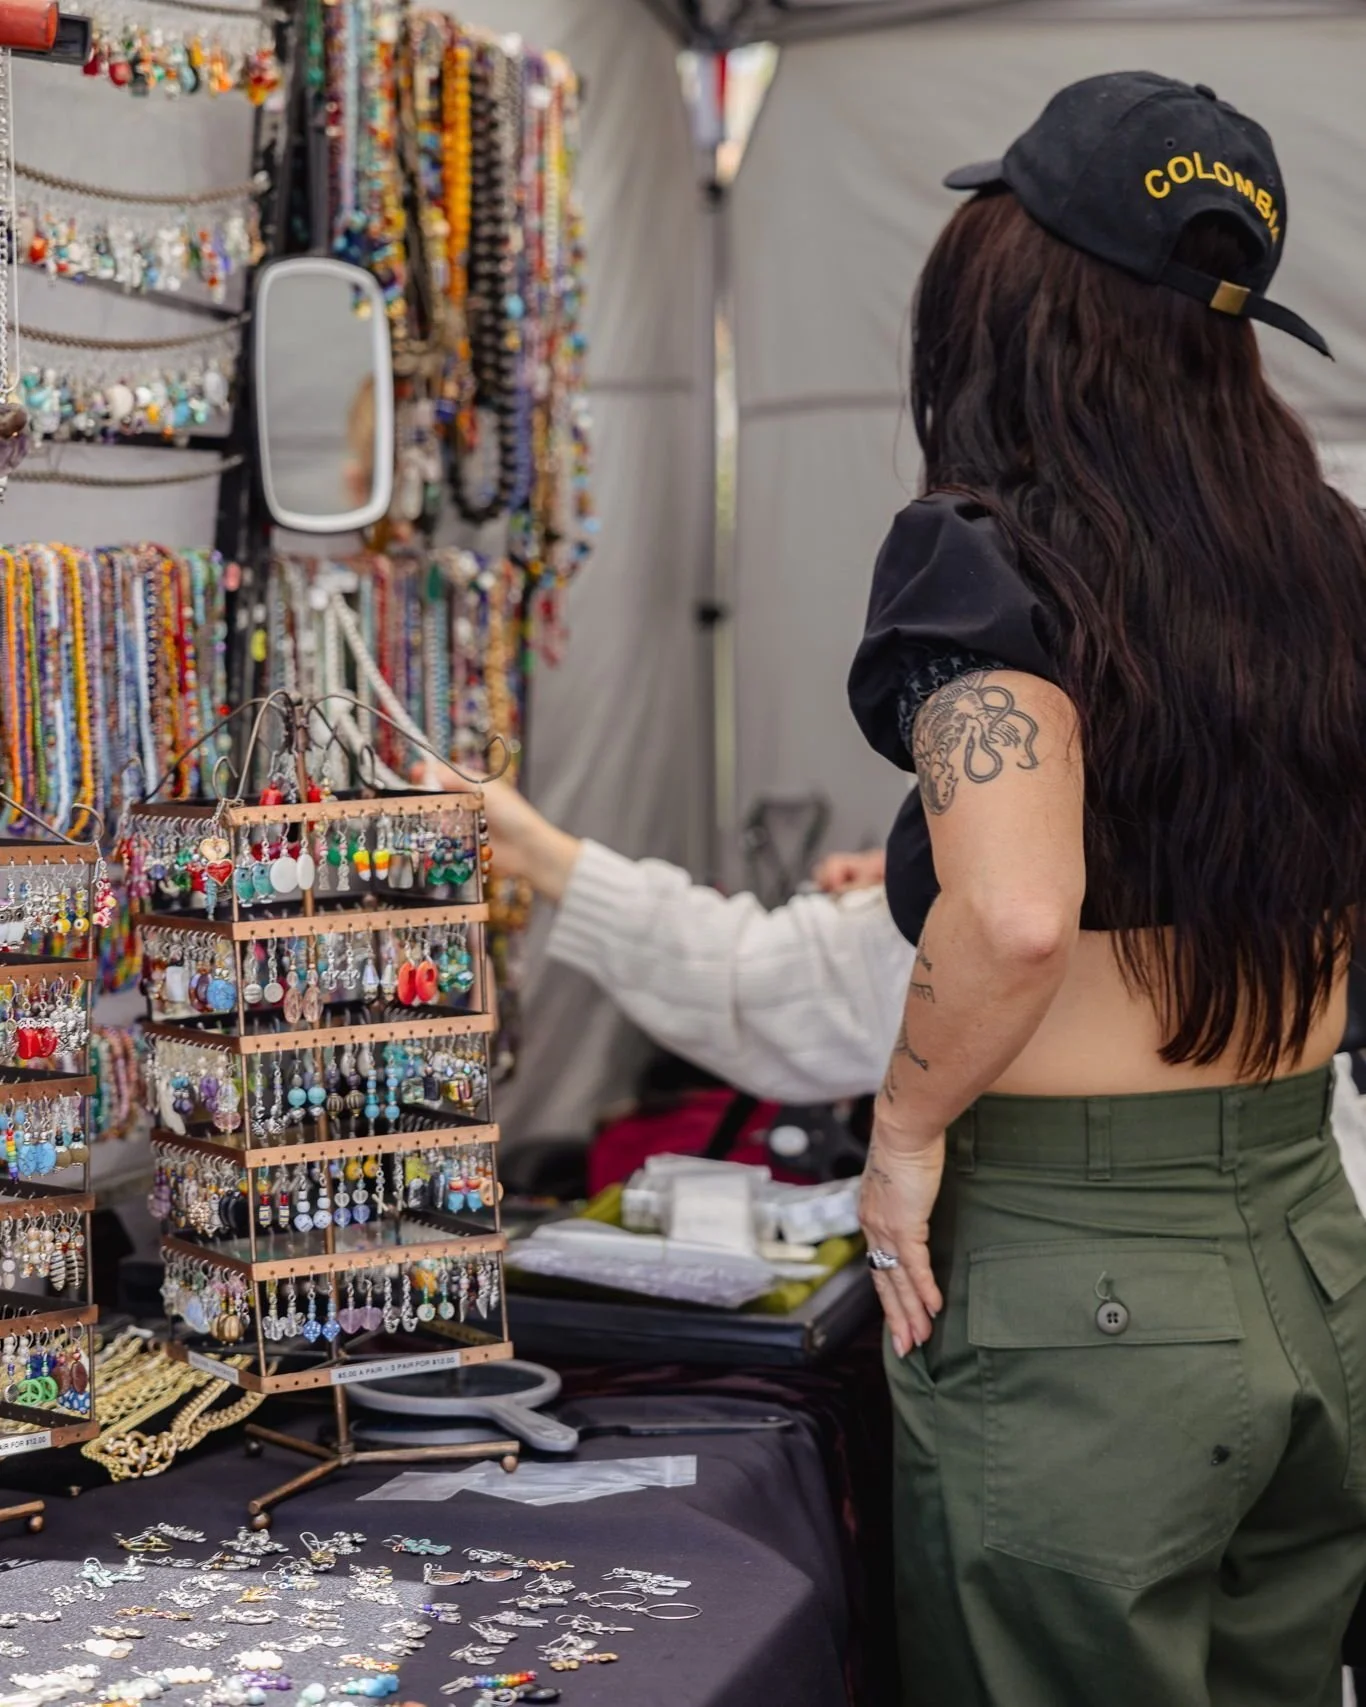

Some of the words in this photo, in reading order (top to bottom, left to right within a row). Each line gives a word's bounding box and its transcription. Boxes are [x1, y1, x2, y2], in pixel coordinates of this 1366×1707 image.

[365, 1366, 383, 1375] PAIR
[397, 1361, 414, 1370] PAIR
[415, 1359, 430, 1367] FOR
[11, 1440, 24, 1449] FOR
